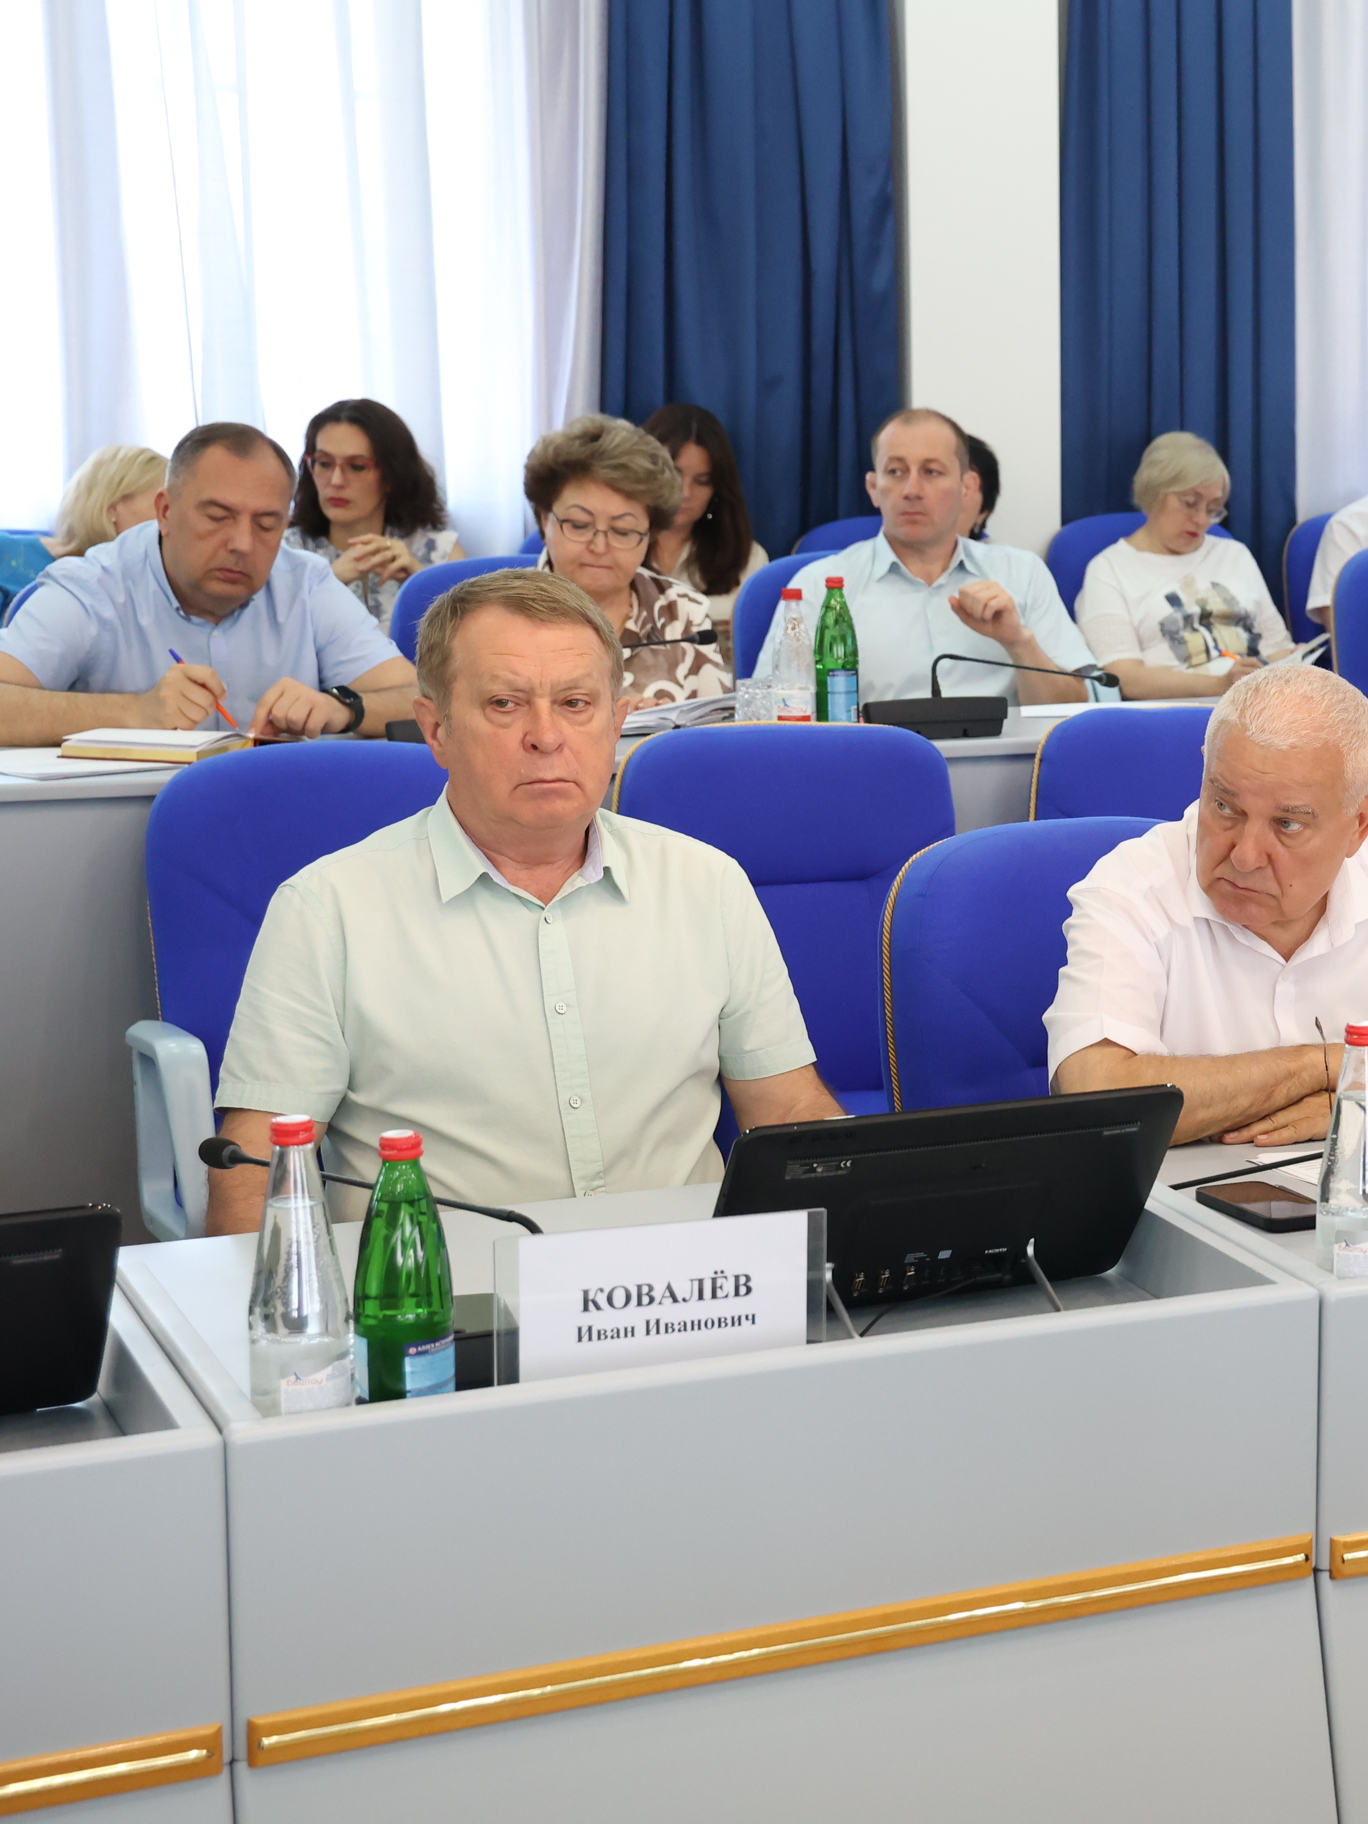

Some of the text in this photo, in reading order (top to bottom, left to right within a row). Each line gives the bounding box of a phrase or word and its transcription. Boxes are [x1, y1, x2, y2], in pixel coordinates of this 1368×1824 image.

[580, 1270, 753, 1313] КОВАЛЁВ
[576, 1313, 757, 1343] Иван Иванович
